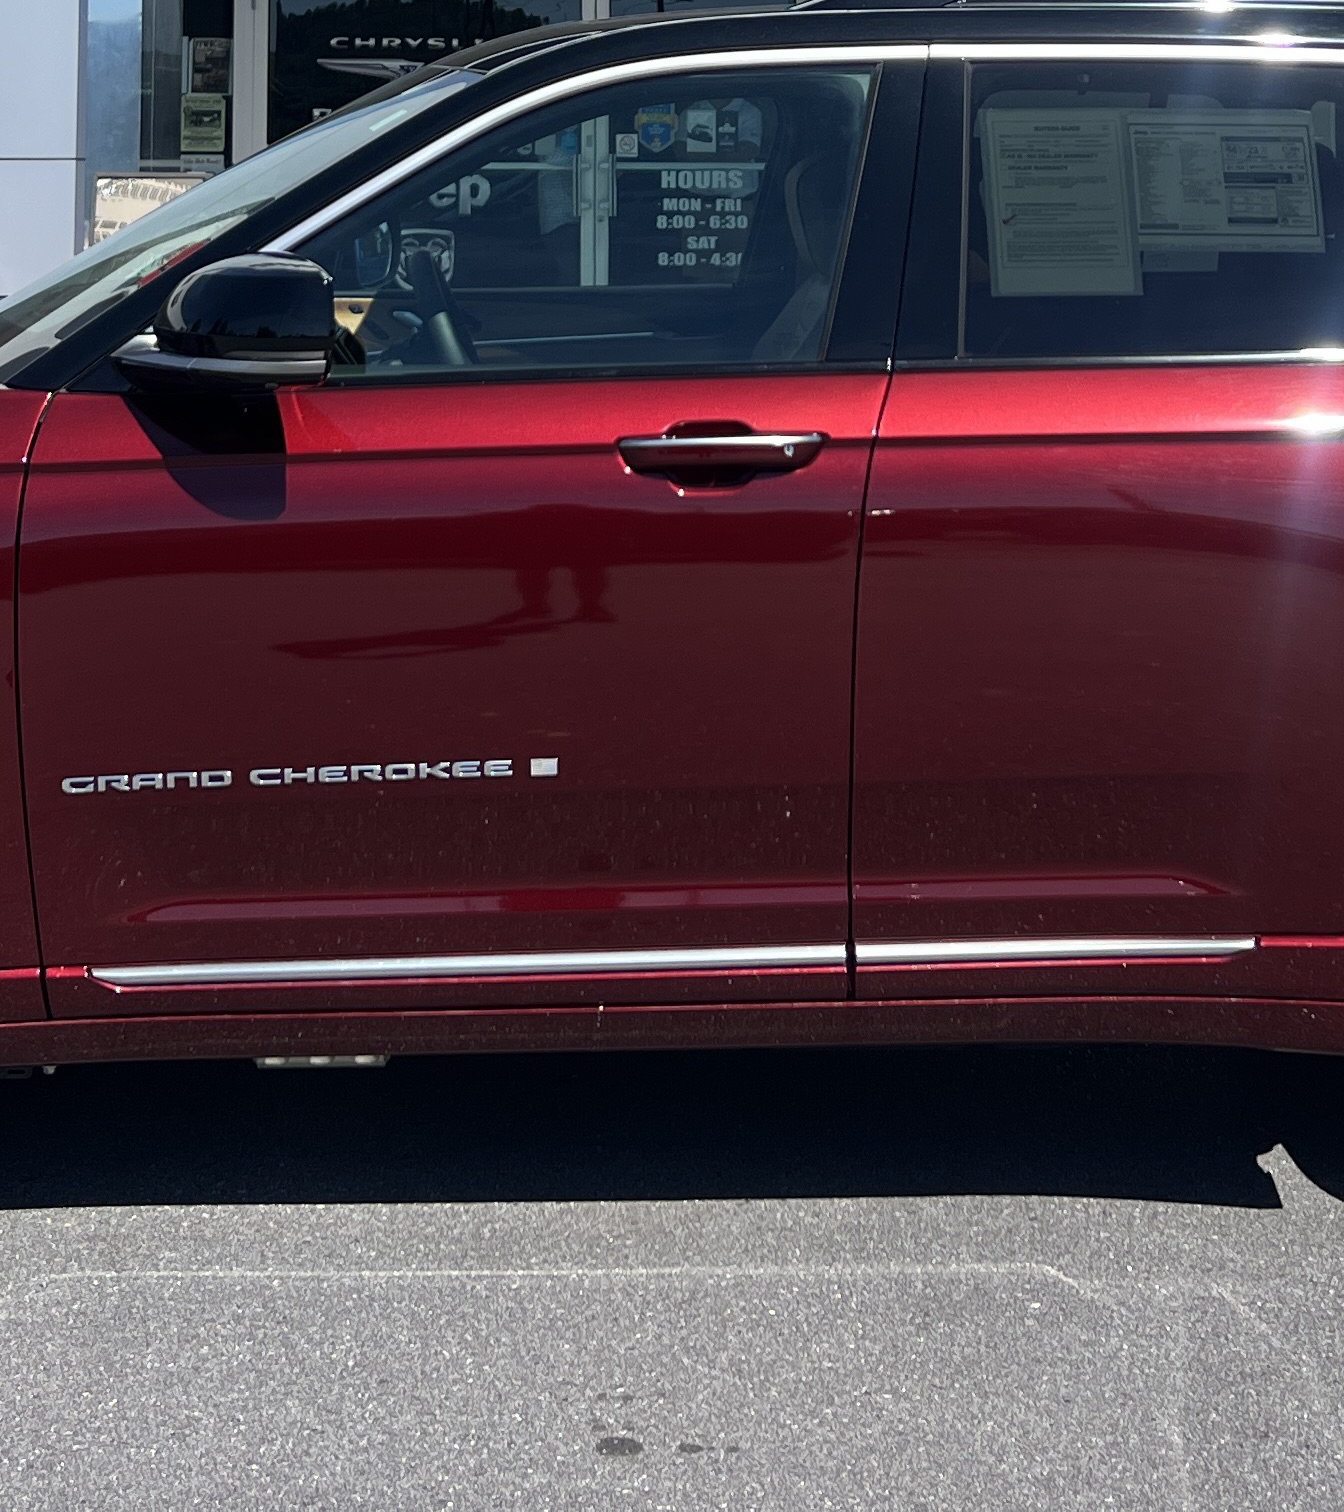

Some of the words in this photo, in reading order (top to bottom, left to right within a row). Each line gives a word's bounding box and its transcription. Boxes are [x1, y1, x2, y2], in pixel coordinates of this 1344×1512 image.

[329, 36, 485, 50] CHRYSL
[660, 169, 744, 189] HOURS
[662, 197, 702, 212] MON
[715, 197, 742, 212] FRI
[656, 214, 696, 229] 8:00
[709, 214, 748, 229] 6:30
[686, 235, 719, 250] SAT
[657, 251, 697, 267] 8:00
[60, 768, 233, 795] GRAND
[248, 758, 515, 787] CHEROKEE
